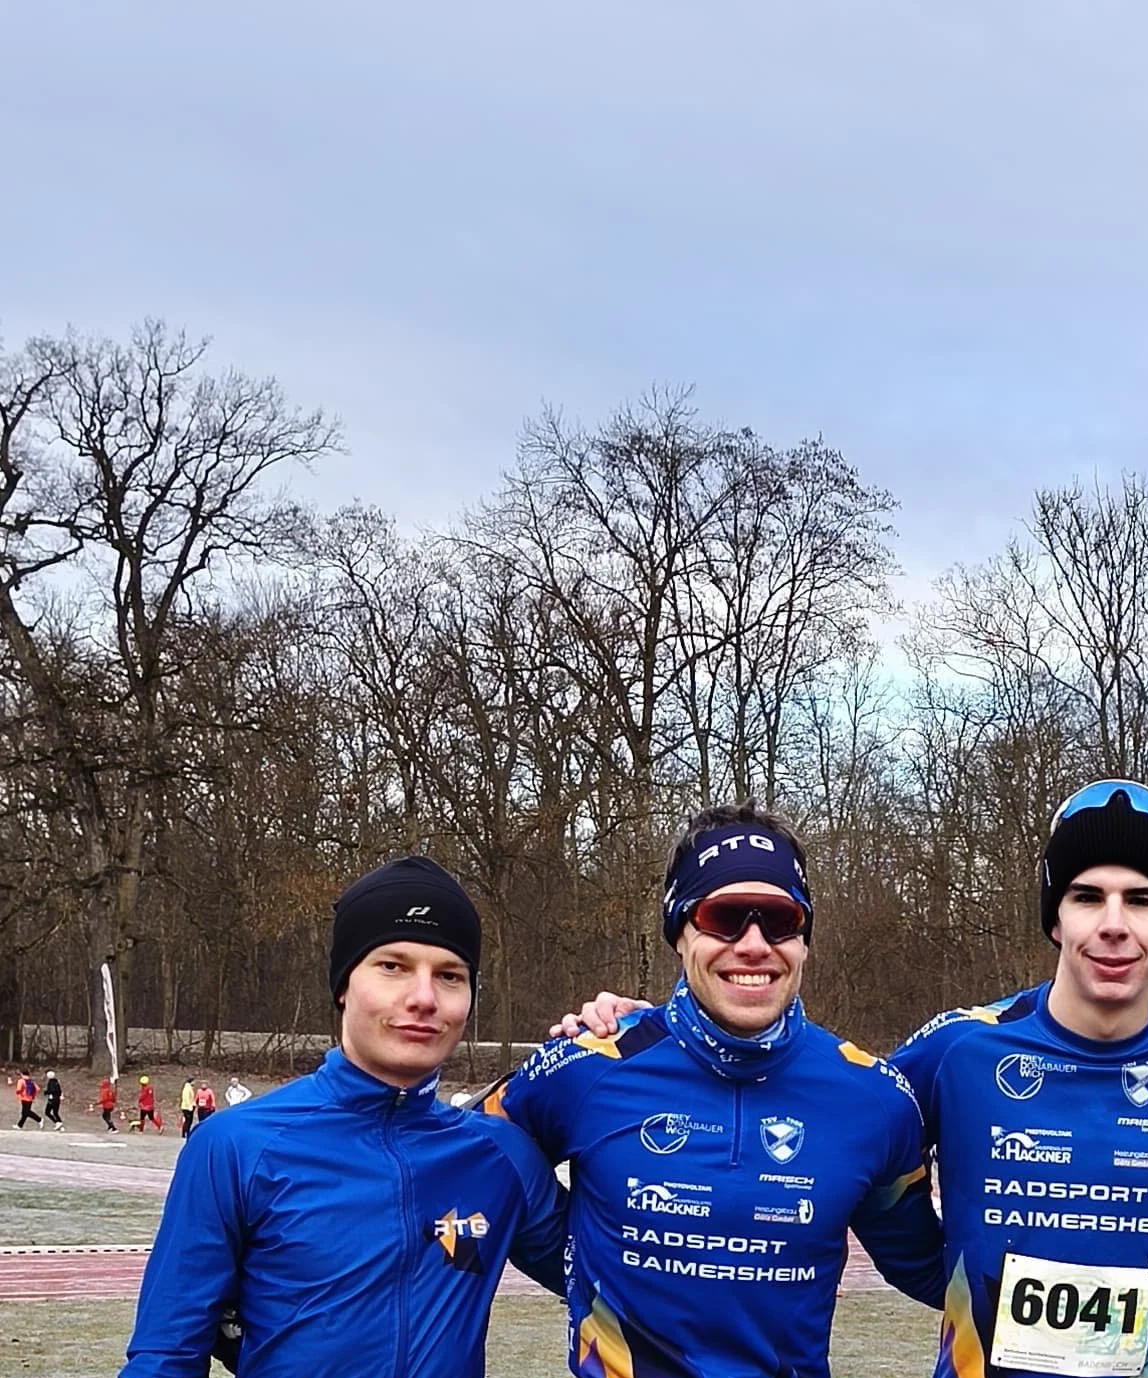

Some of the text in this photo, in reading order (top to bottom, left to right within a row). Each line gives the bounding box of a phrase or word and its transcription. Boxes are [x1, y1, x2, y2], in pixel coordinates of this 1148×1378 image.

[698, 835, 775, 868] RTG
[528, 1048, 565, 1081] SPORT
[984, 1178, 1148, 1203] RADSPORT
[434, 1218, 489, 1237] RTG
[621, 1225, 788, 1254] RADSPORT
[622, 1250, 816, 1282] GAIMERSHEIM
[1011, 1277, 1138, 1334] 6041
